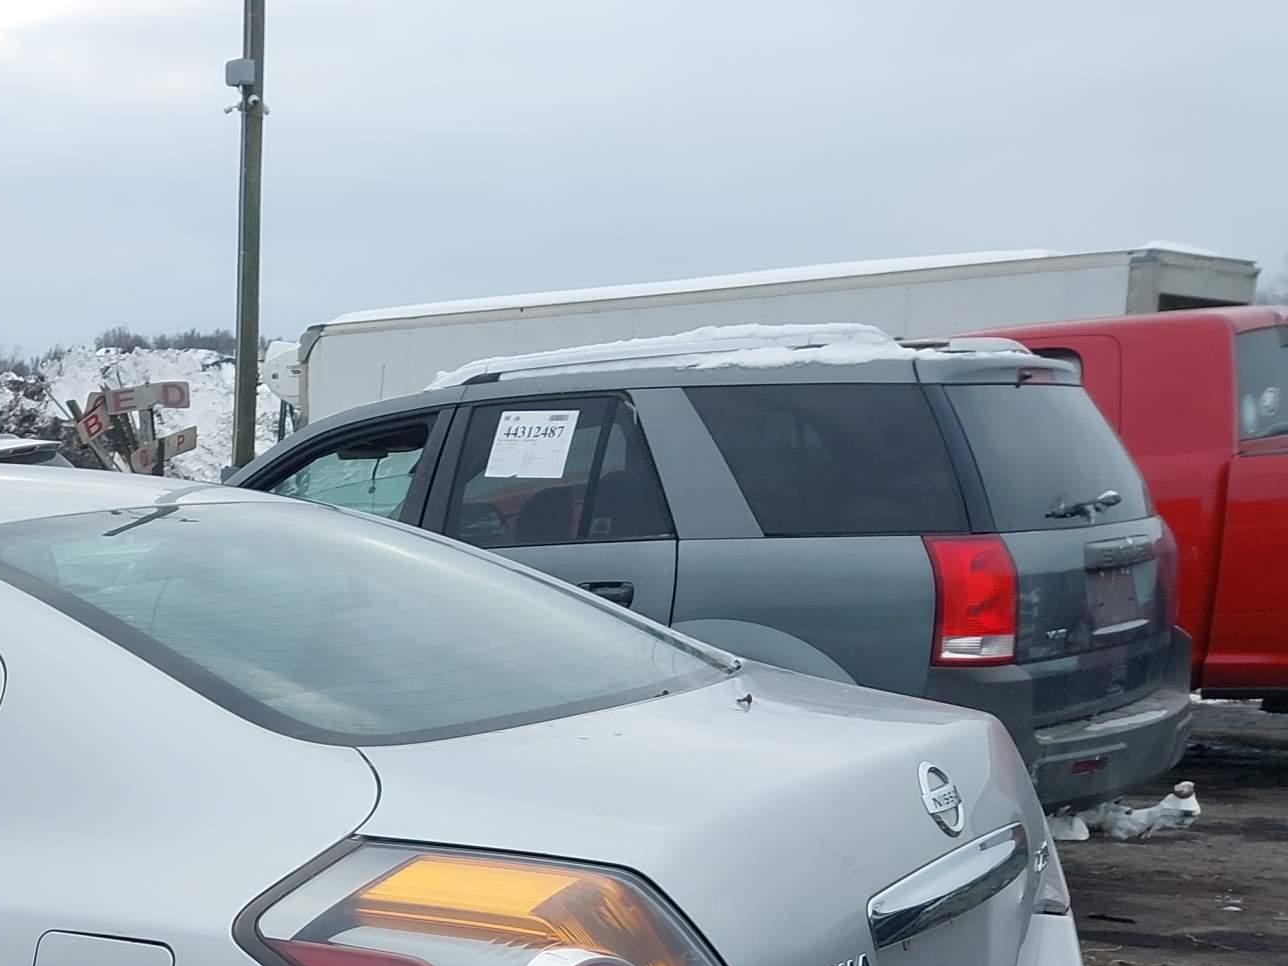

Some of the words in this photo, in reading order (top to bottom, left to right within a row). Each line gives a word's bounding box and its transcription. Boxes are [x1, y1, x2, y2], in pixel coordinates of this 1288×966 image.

[162, 383, 185, 406] D
[84, 414, 104, 438] B
[503, 425, 566, 439] 44312487
[176, 434, 185, 450] P
